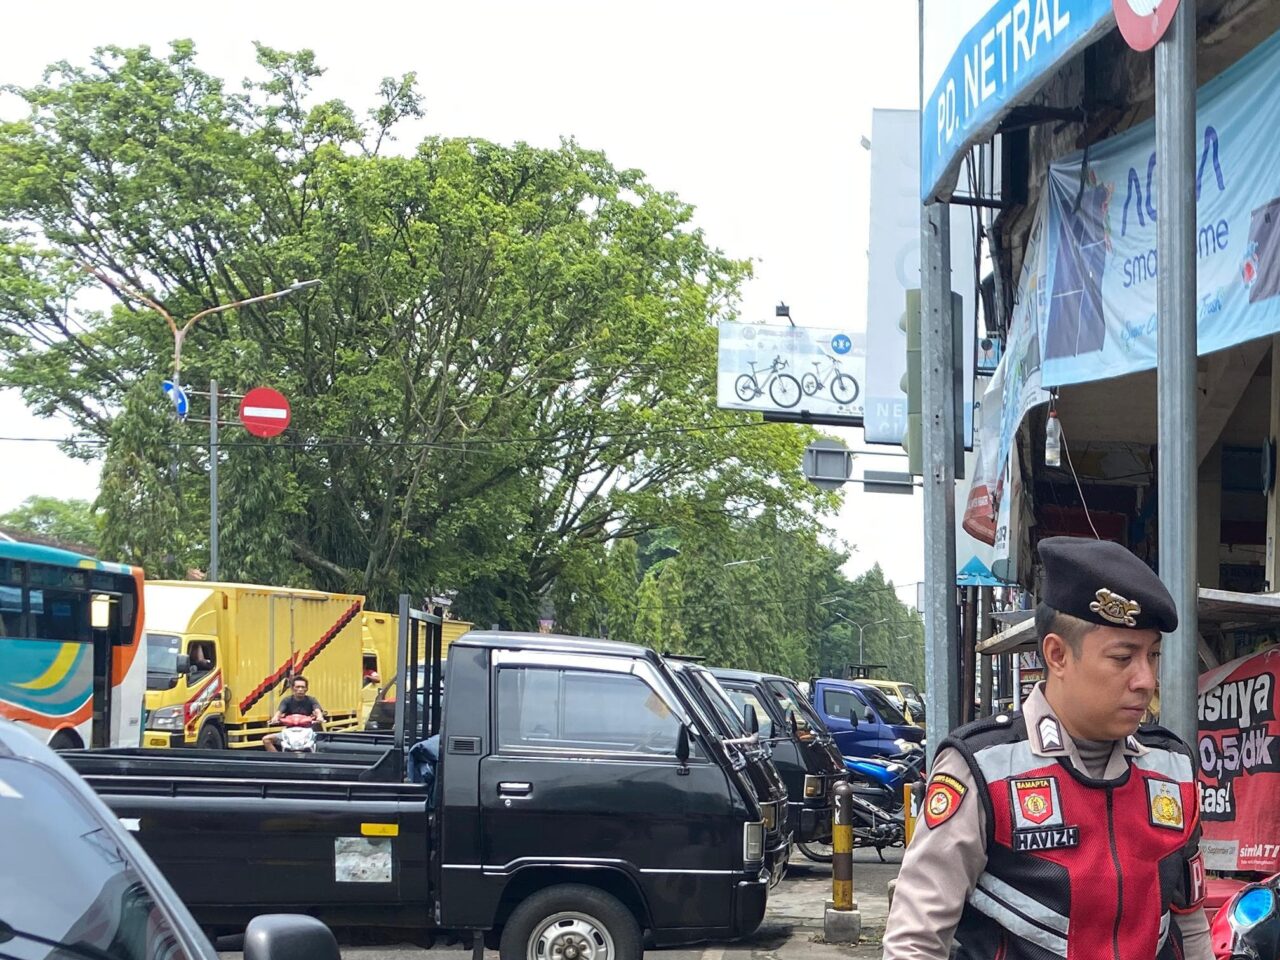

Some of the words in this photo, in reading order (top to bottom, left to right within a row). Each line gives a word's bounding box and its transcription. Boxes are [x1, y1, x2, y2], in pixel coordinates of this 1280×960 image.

[937, 77, 960, 157] PD.
[963, 0, 1070, 119] NETRAL
[1016, 780, 1050, 790] SAMAPTA
[1018, 829, 1077, 850] HAVIZH
